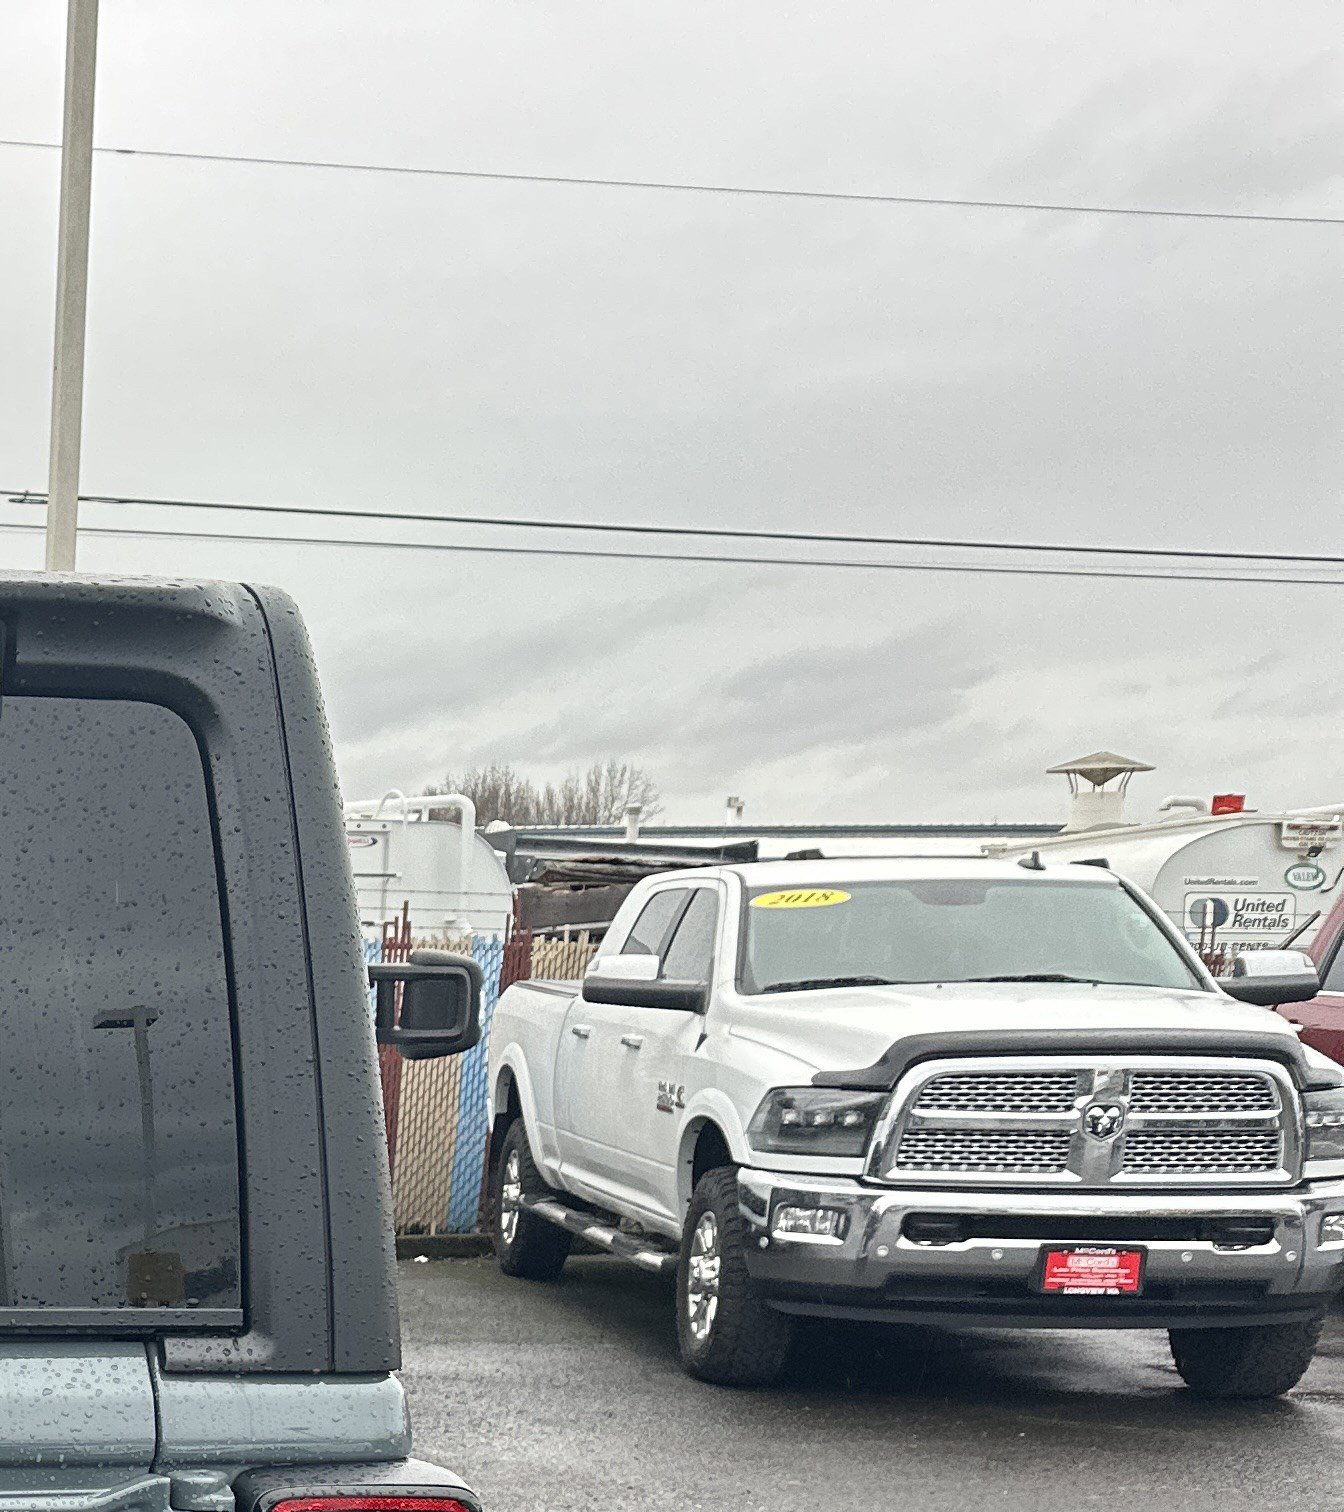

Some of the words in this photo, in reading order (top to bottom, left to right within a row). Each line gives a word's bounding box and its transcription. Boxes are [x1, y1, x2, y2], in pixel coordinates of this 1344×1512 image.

[768, 891, 835, 905] 2018
[1233, 898, 1286, 912] United
[1232, 912, 1290, 928] Rentals
